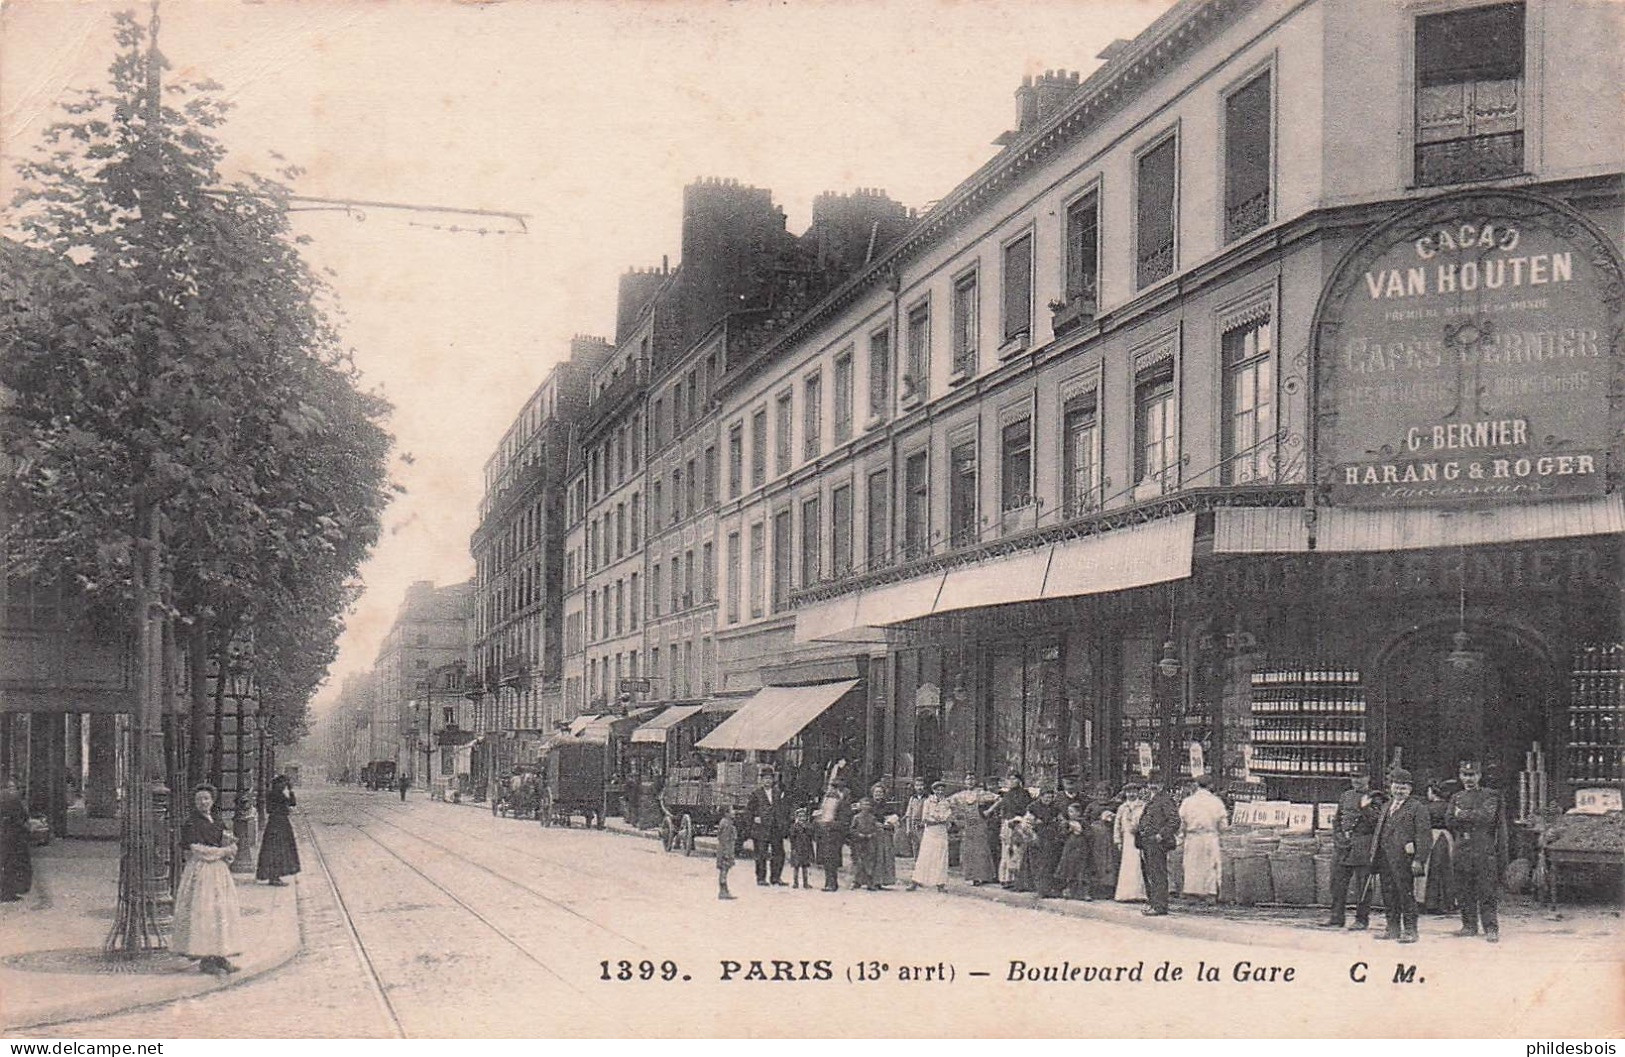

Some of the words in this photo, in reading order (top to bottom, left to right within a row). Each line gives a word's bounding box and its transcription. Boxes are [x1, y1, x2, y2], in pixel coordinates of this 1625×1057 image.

[1415, 224, 1520, 259] CACAO
[1365, 266, 1426, 299] VAN
[1438, 252, 1572, 294] HOUTEN
[1433, 419, 1527, 450] BERNIER
[1345, 462, 1460, 485] HARANG
[1469, 462, 1483, 479] &
[1493, 455, 1595, 478] ROGER
